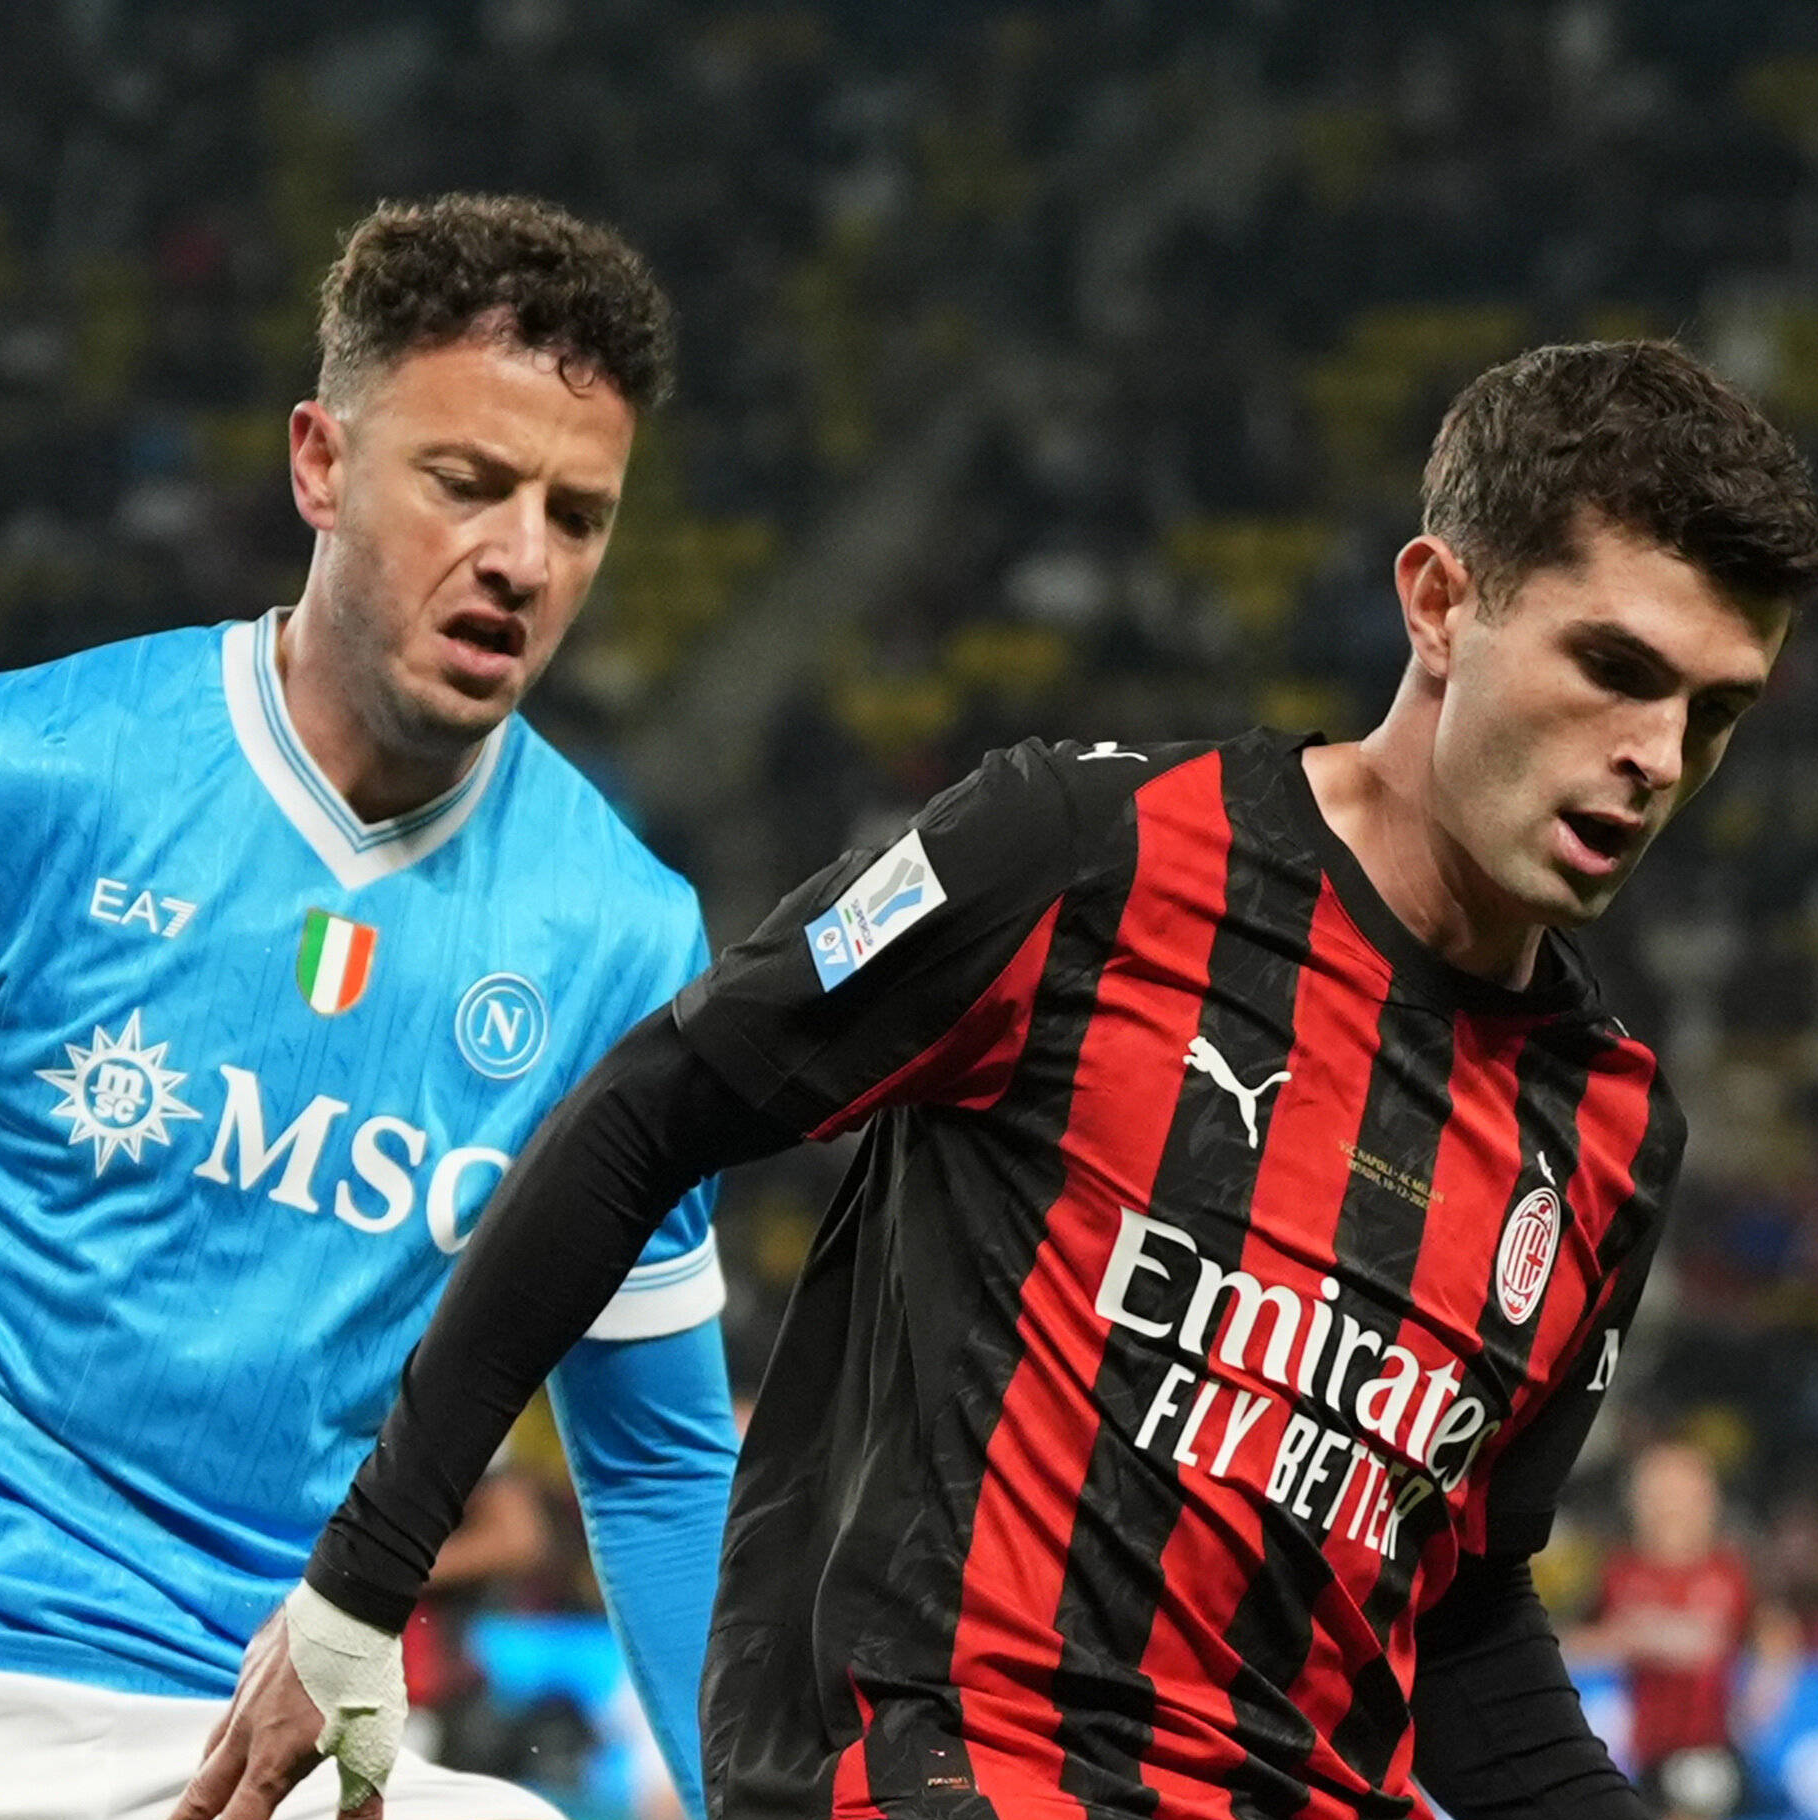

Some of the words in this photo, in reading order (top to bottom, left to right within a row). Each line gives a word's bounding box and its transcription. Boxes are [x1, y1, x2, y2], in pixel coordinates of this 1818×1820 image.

[89, 877, 198, 938] EA7
[477, 998, 525, 1052] N
[1095, 1206, 1501, 1492] Emirates
[1134, 1362, 1273, 1477] FLY
[1264, 1412, 1435, 1559] BETTER
